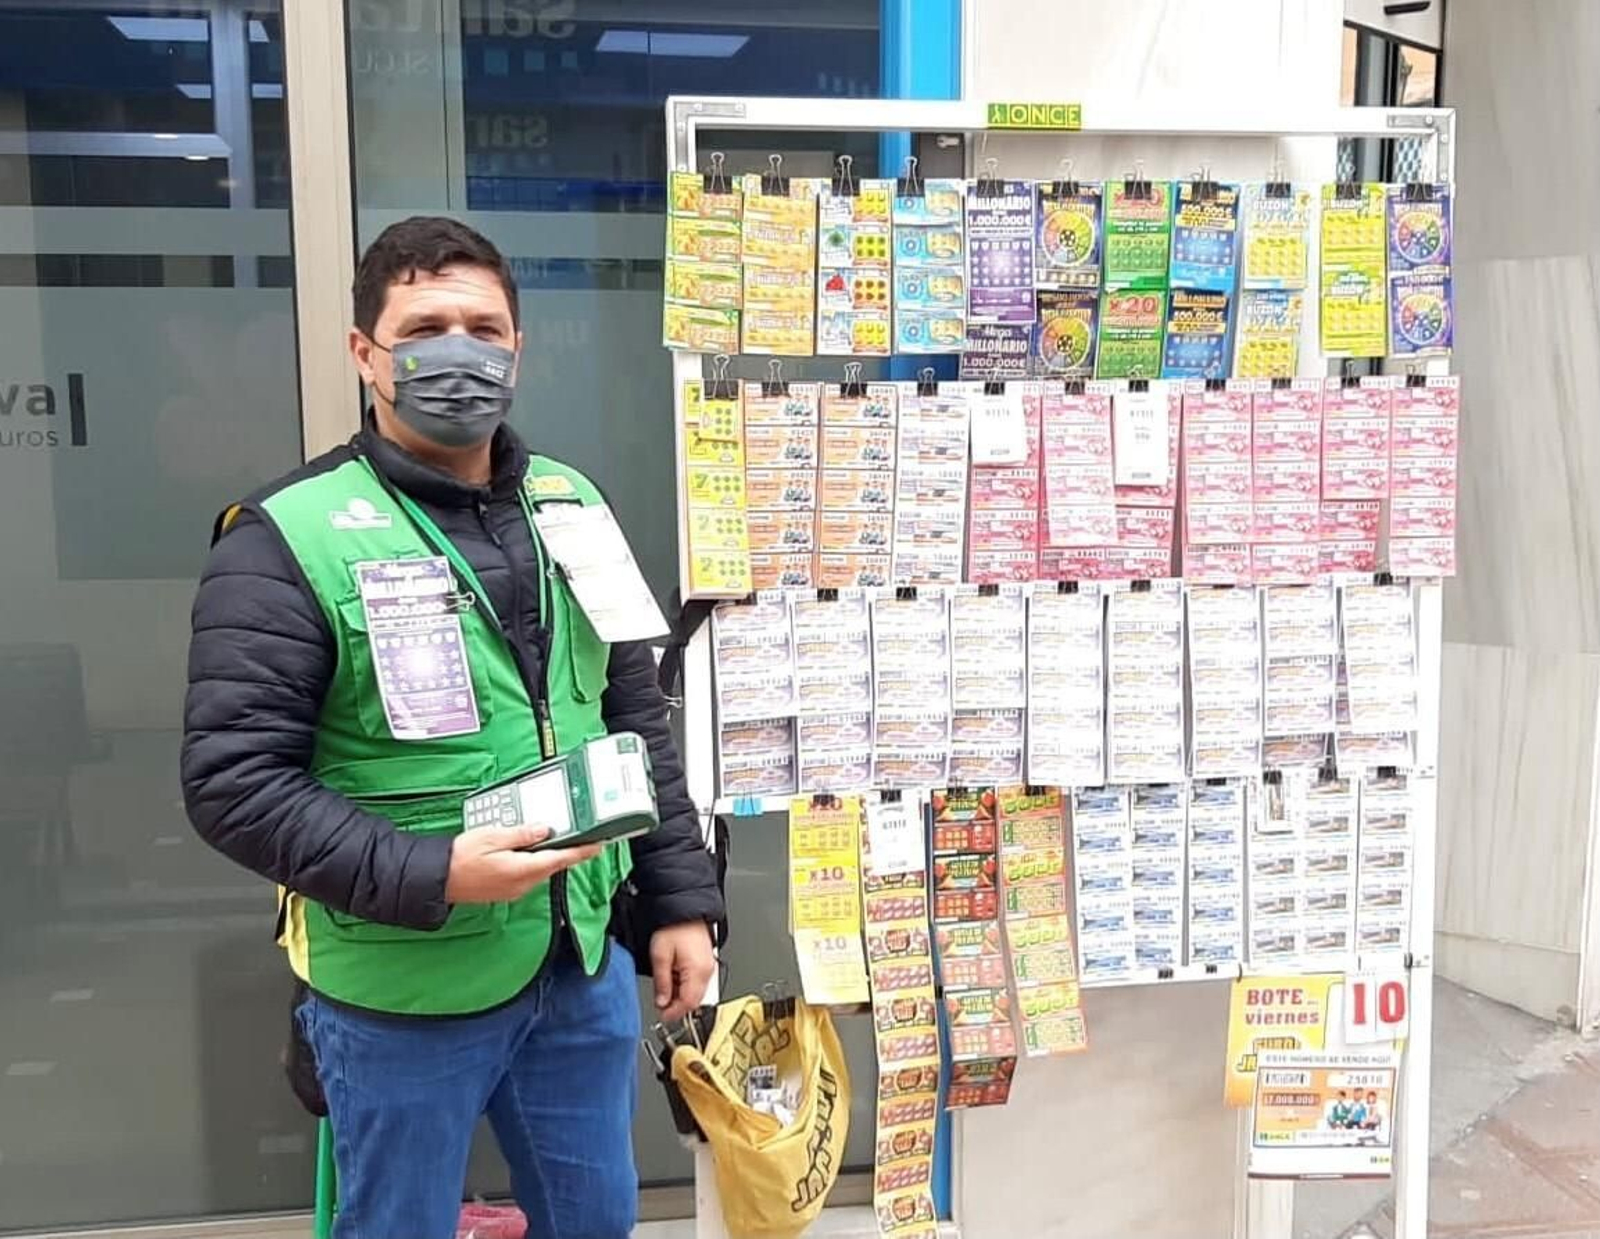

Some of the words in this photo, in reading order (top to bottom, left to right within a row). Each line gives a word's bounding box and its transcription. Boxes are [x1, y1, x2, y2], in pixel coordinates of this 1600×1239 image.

[1010, 104, 1080, 125] ONCE
[1246, 988, 1303, 1006] BOTE
[1353, 981, 1405, 1025] 10
[1245, 1008, 1319, 1025] viernes
